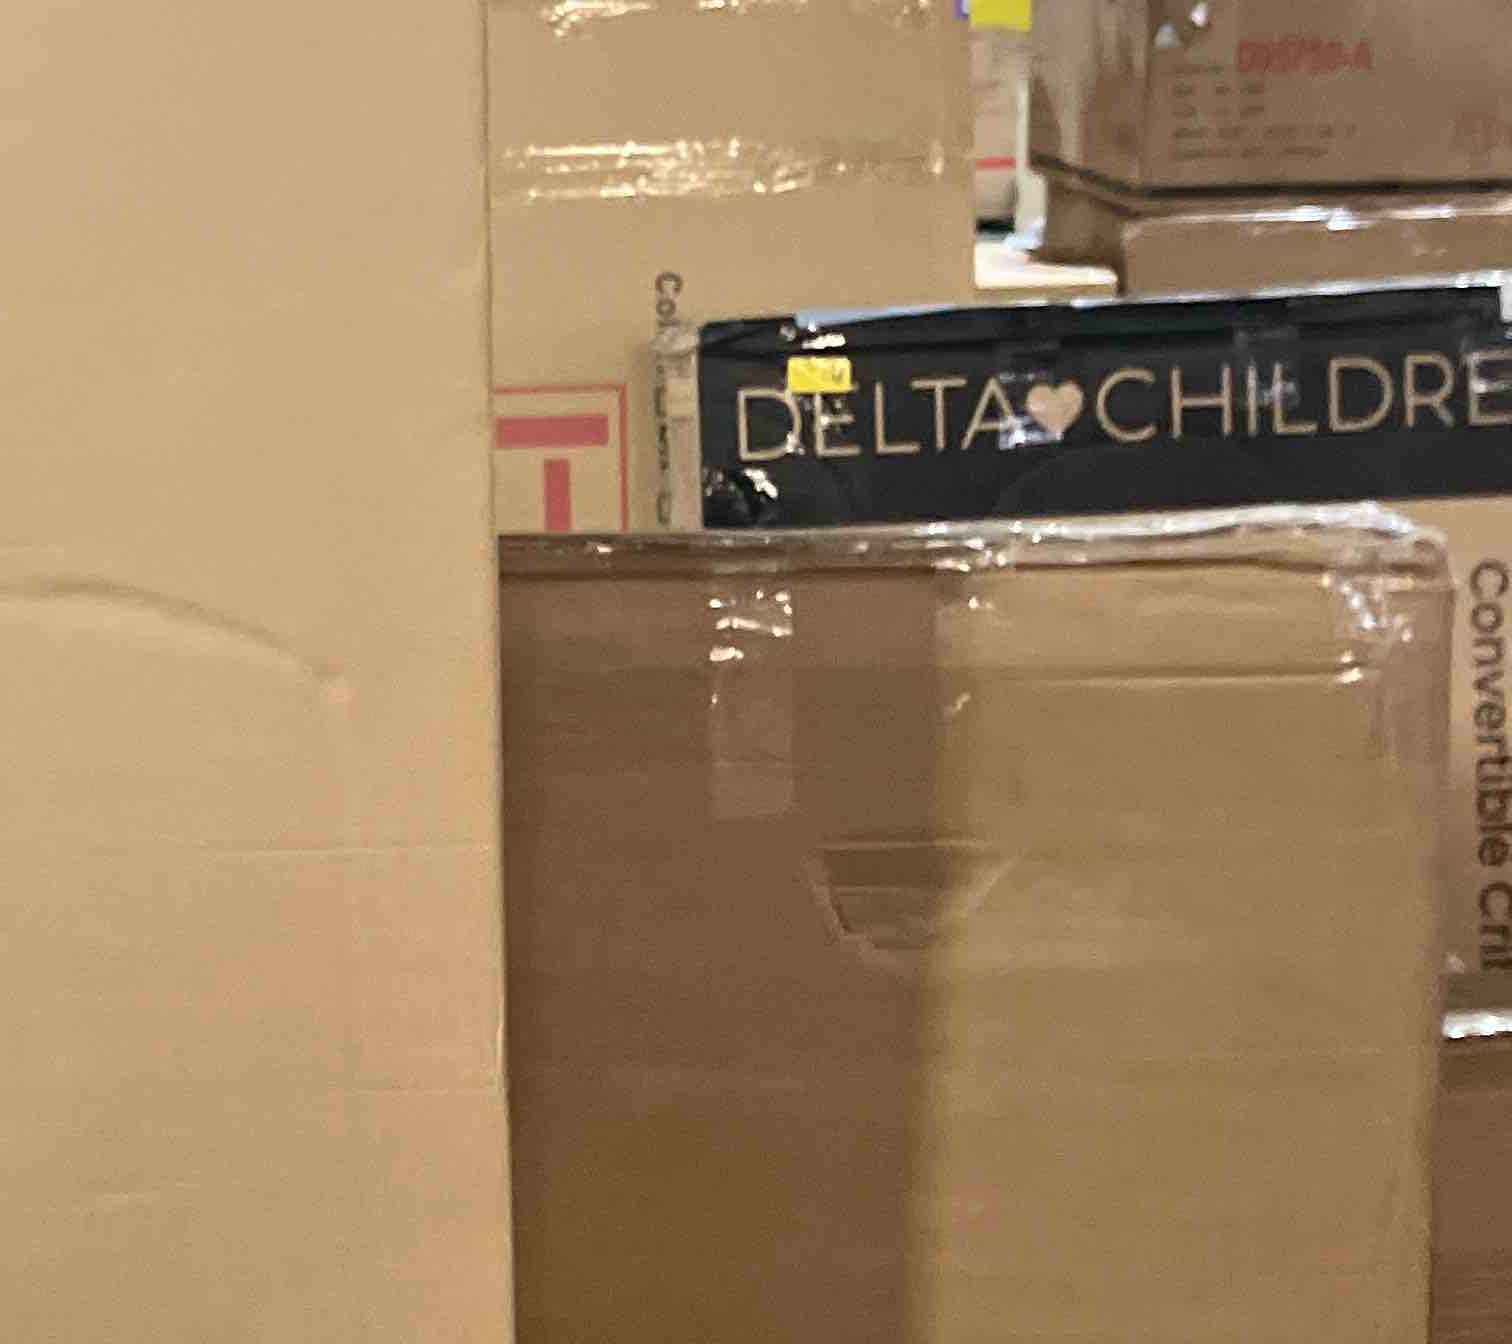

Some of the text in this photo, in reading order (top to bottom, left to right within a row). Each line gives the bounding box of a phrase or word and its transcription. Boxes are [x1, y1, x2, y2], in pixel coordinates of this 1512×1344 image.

[736, 374, 1023, 462] DELTA
[1095, 346, 1512, 443] CHILDRE
[1469, 558, 1512, 868] Convertible
